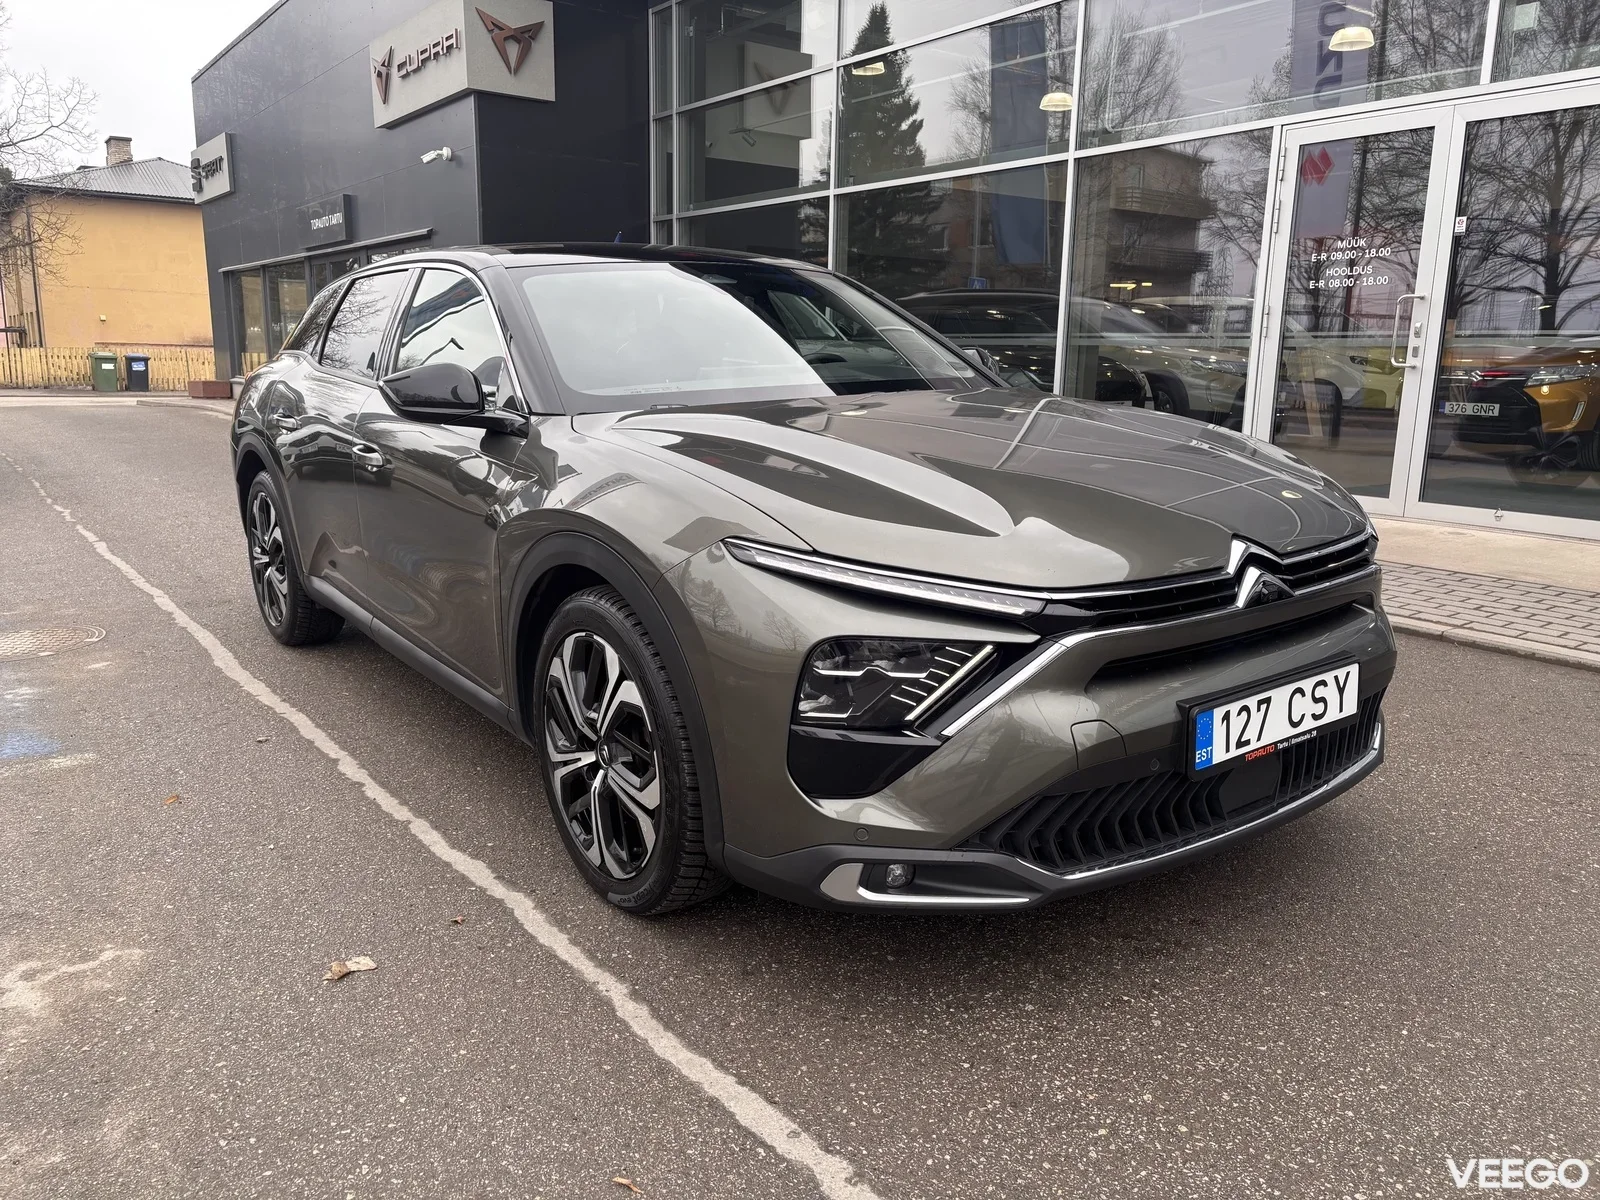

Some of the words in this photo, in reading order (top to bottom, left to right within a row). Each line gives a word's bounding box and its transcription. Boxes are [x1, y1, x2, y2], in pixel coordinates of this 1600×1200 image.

[396, 28, 460, 78] CUPRA
[310, 215, 329, 230] TOPAUTO
[329, 212, 343, 225] TARTU
[1337, 236, 1367, 249] MÜÜK
[1311, 252, 1327, 262] E-R
[1330, 250, 1356, 261] 09.00
[1364, 247, 1391, 258] 18.00
[1325, 265, 1373, 277] HOOLDUS
[1309, 280, 1325, 289] E-R
[1328, 278, 1355, 288] 08.00
[1362, 275, 1389, 286] 18.00
[1448, 403, 1467, 414] 376
[1471, 404, 1496, 415] GNR
[1221, 695, 1273, 754] 127
[1287, 670, 1351, 729] CSY
[1195, 746, 1212, 763] EST
[1245, 744, 1275, 761] TOPAUTO
[1277, 741, 1288, 750] Tartu
